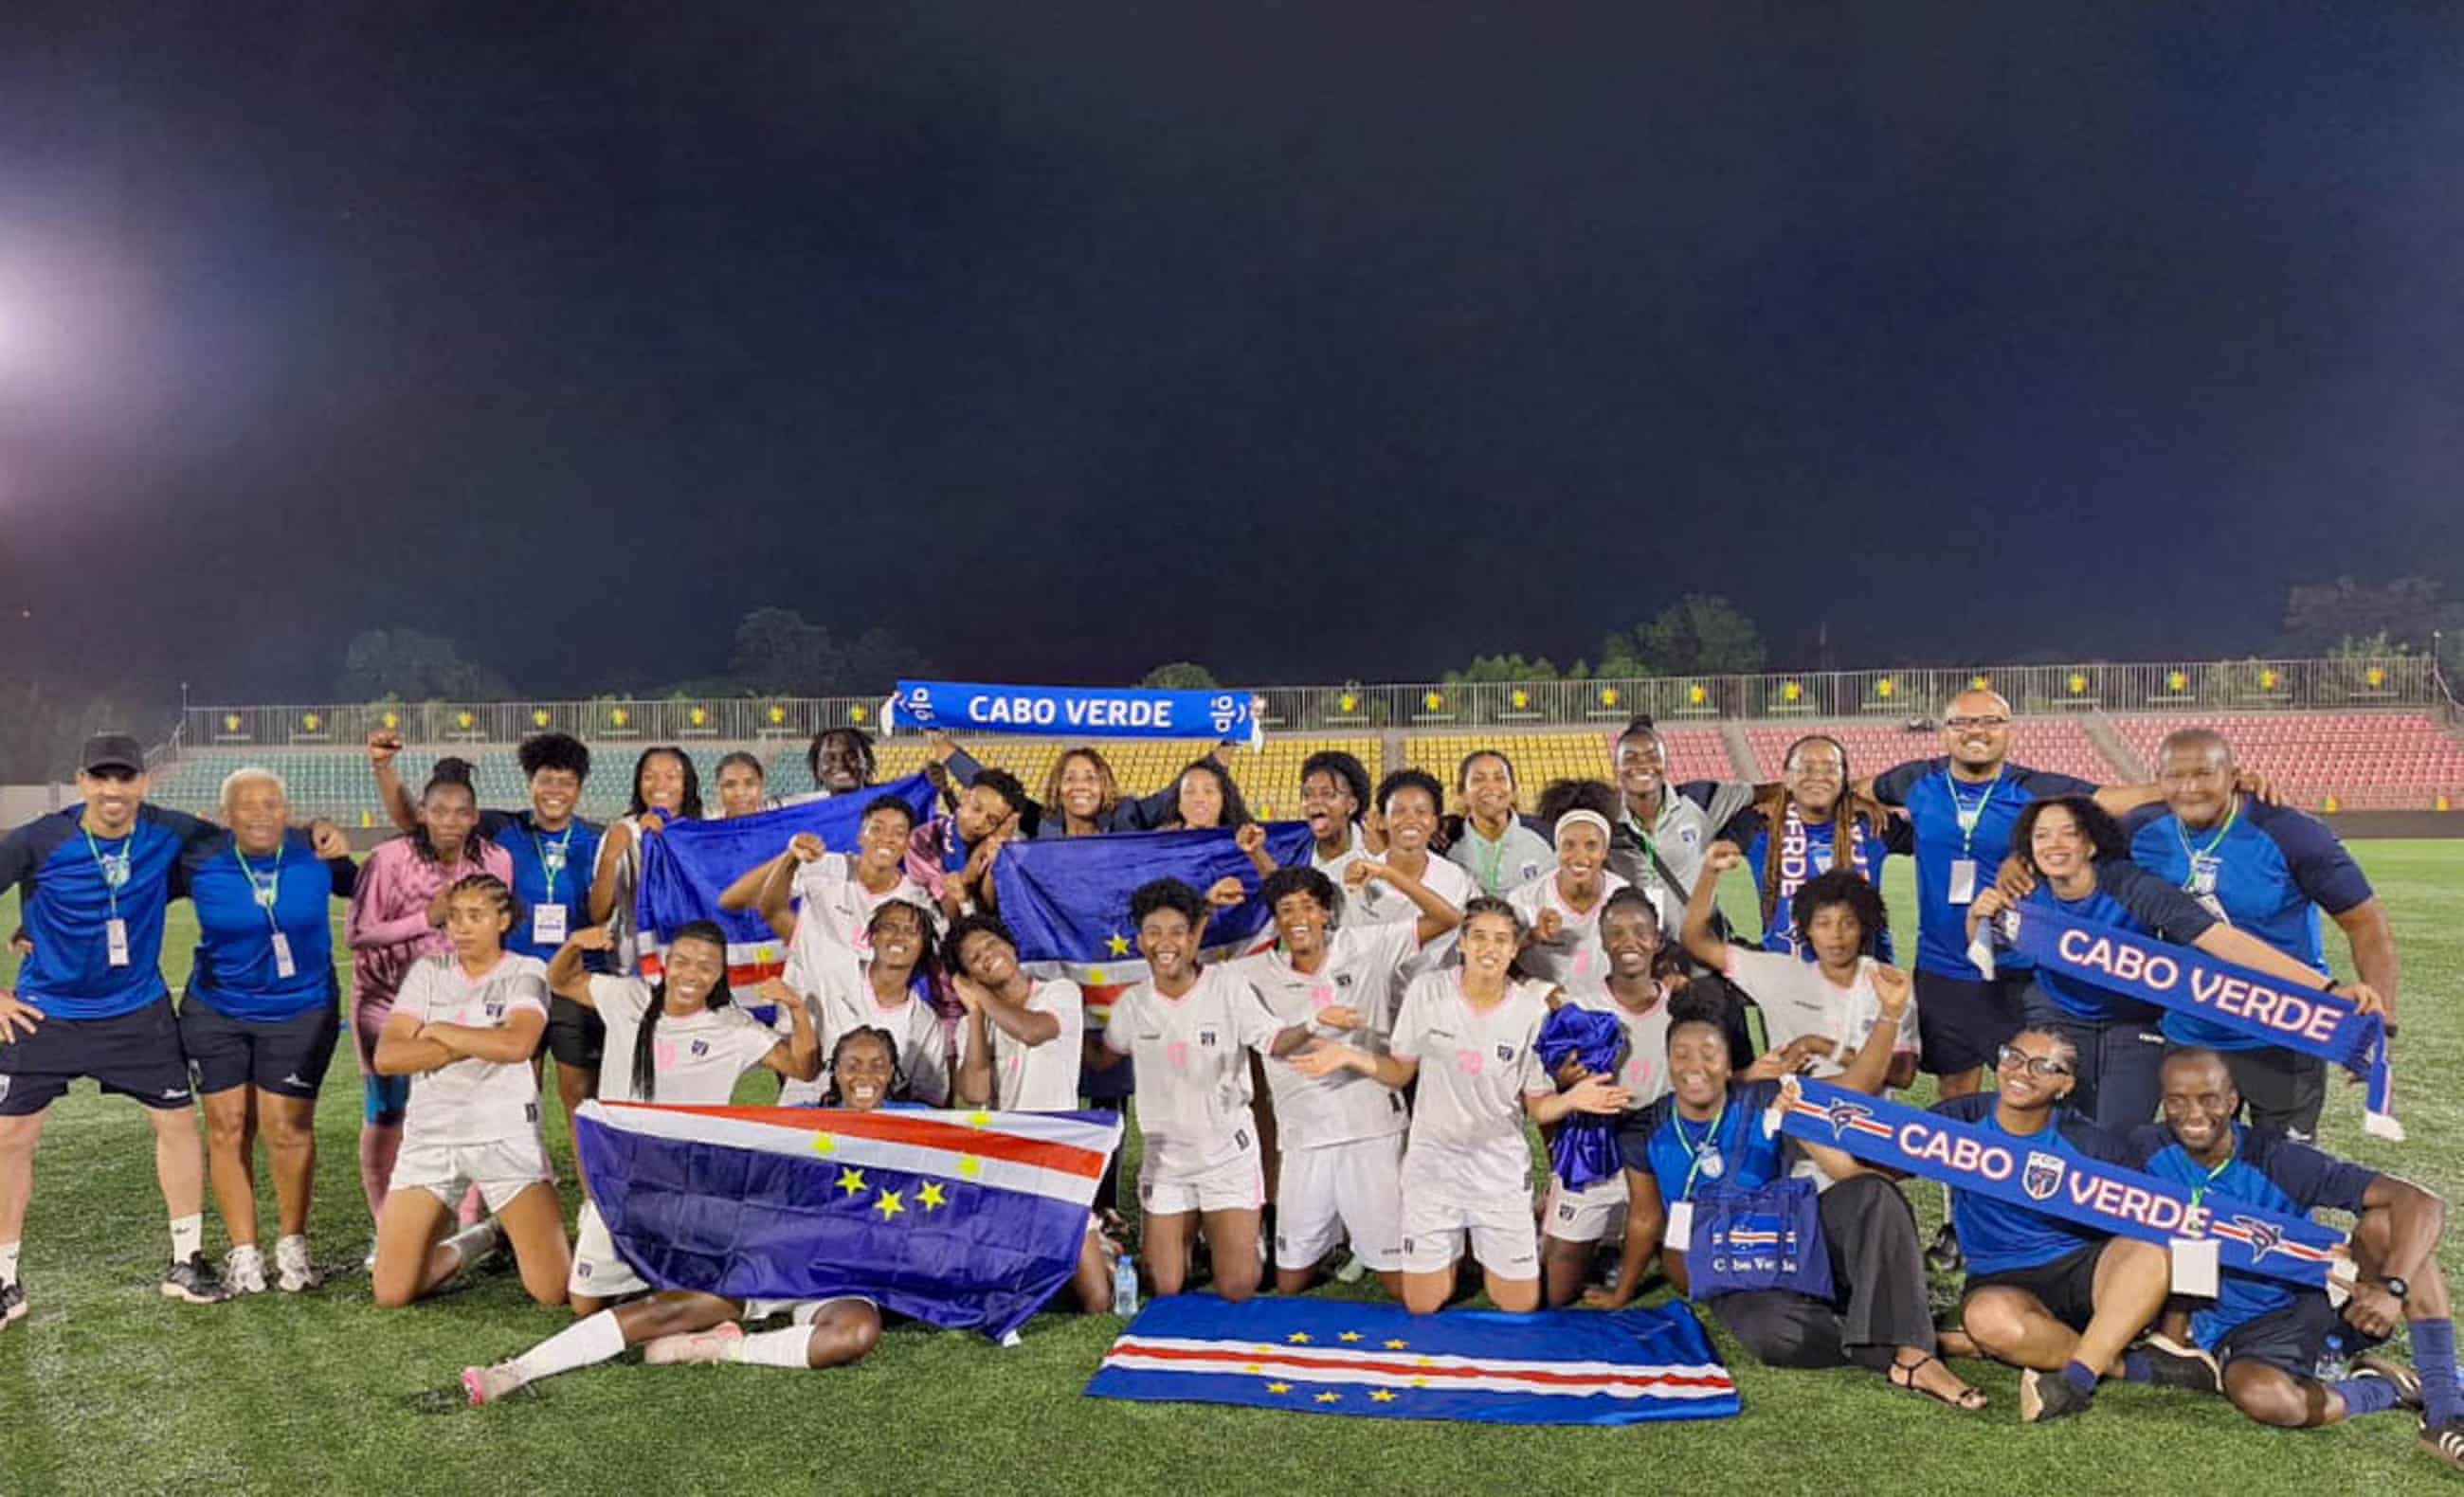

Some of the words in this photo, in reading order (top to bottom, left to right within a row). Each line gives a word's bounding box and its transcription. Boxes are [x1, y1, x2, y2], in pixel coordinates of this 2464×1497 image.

[969, 695, 1057, 725] CABO
[1065, 697, 1173, 727] VERDE
[2058, 929, 2179, 990] CABO
[2189, 967, 2343, 1042] VERDE
[1898, 1124, 2013, 1181] CABO
[2068, 1170, 2213, 1237] VERDE
[1712, 1257, 1752, 1272] Cbo
